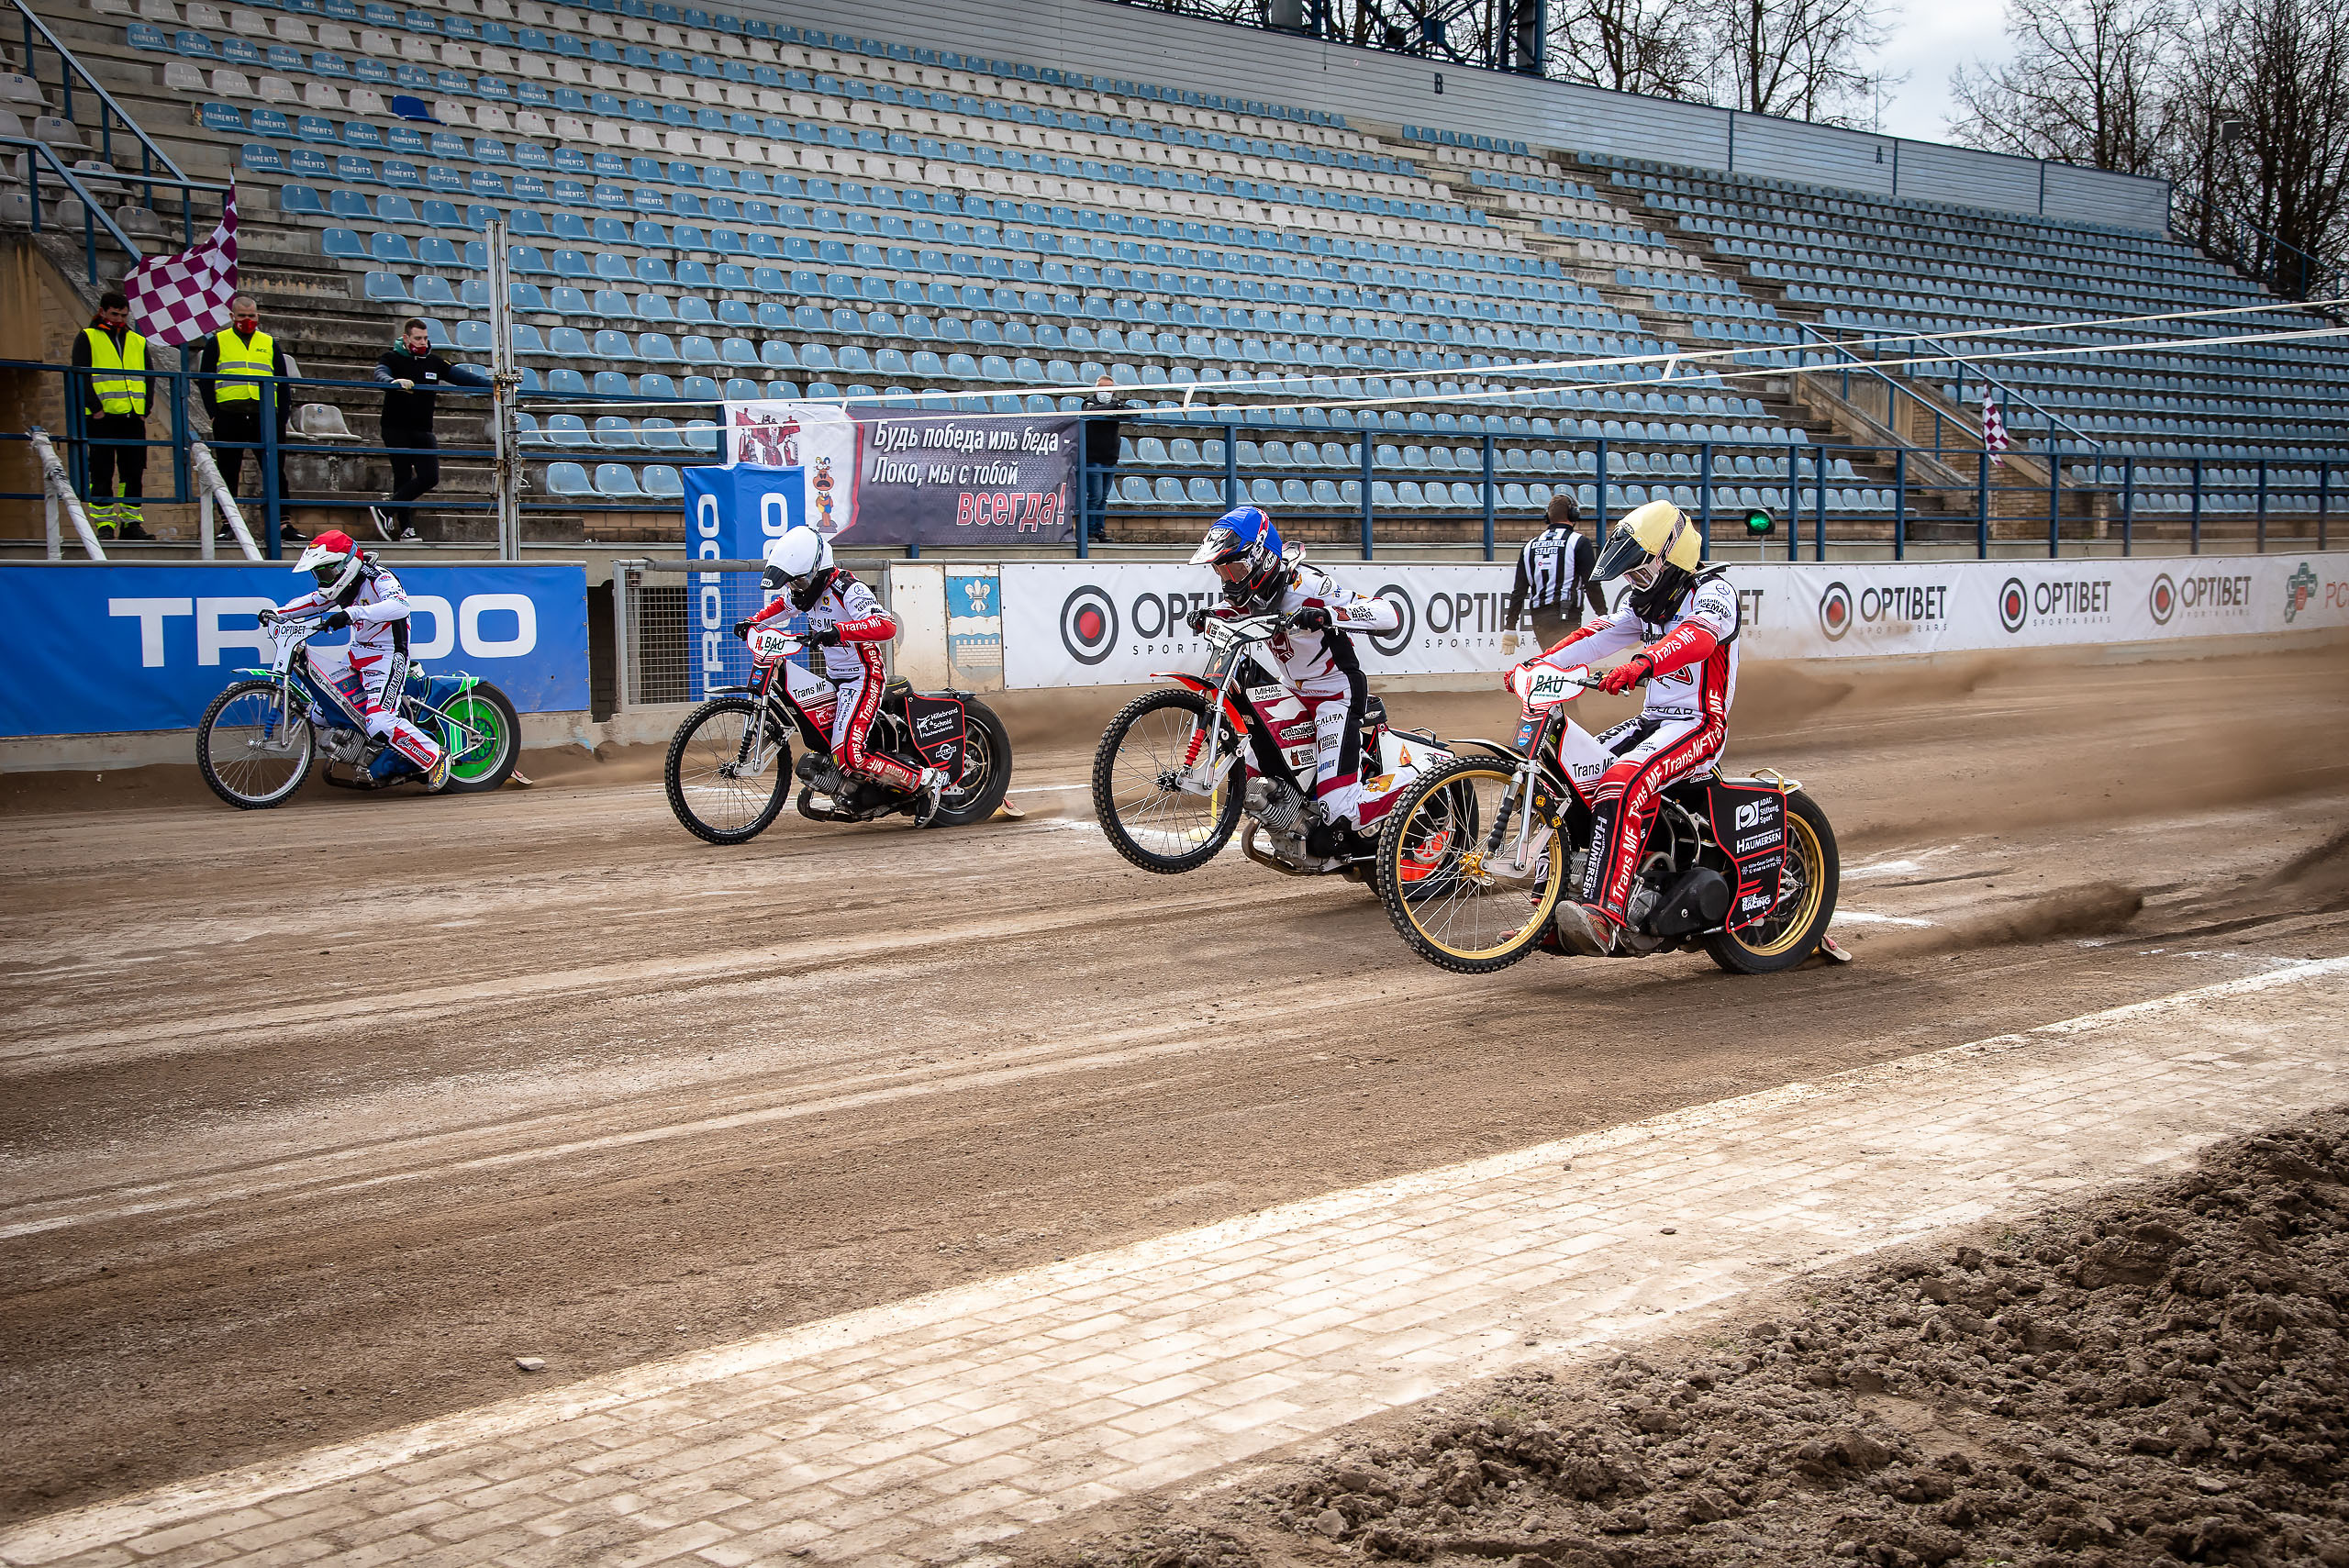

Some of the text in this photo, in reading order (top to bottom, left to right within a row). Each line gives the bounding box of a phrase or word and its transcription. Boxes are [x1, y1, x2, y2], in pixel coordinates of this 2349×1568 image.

[14, 76, 23, 84] 10
[1433, 72, 1444, 95] B
[1875, 145, 1883, 165] A
[805, 308, 813, 317] 11
[850, 349, 858, 357] 11
[874, 420, 918, 453] Будь
[921, 422, 985, 453] победа
[987, 429, 1019, 451] иль
[1020, 426, 1059, 455] беда
[872, 456, 1019, 488] Локо, мы с тобой
[956, 482, 1067, 532] всегда!
[2034, 580, 2112, 615] OPTIBET
[2180, 575, 2252, 607] OPTIBET
[1860, 585, 1947, 622] OPTIBET
[107, 593, 538, 668] TRDO
[281, 625, 306, 635] OPTIBET
[837, 621, 868, 632] Trans
[2033, 617, 2077, 628] SPORTA
[765, 635, 785, 651] BAU
[1132, 643, 1213, 655] SPORTA
[1425, 639, 1495, 649] SPORTA
[1653, 627, 1698, 664] Trans MF
[793, 680, 827, 701] Trans MF
[1254, 685, 1282, 695] MIHAIL
[1534, 674, 1565, 694] BAU
[1709, 689, 1723, 715] MF
[1572, 762, 1600, 778] Trans
[1760, 795, 1773, 807] ADAC
[1760, 815, 1774, 825] Sport
[1736, 831, 1782, 854] HAUMERSEN
[1612, 824, 1639, 900] Trans MF
[1742, 895, 1772, 912] RACING
